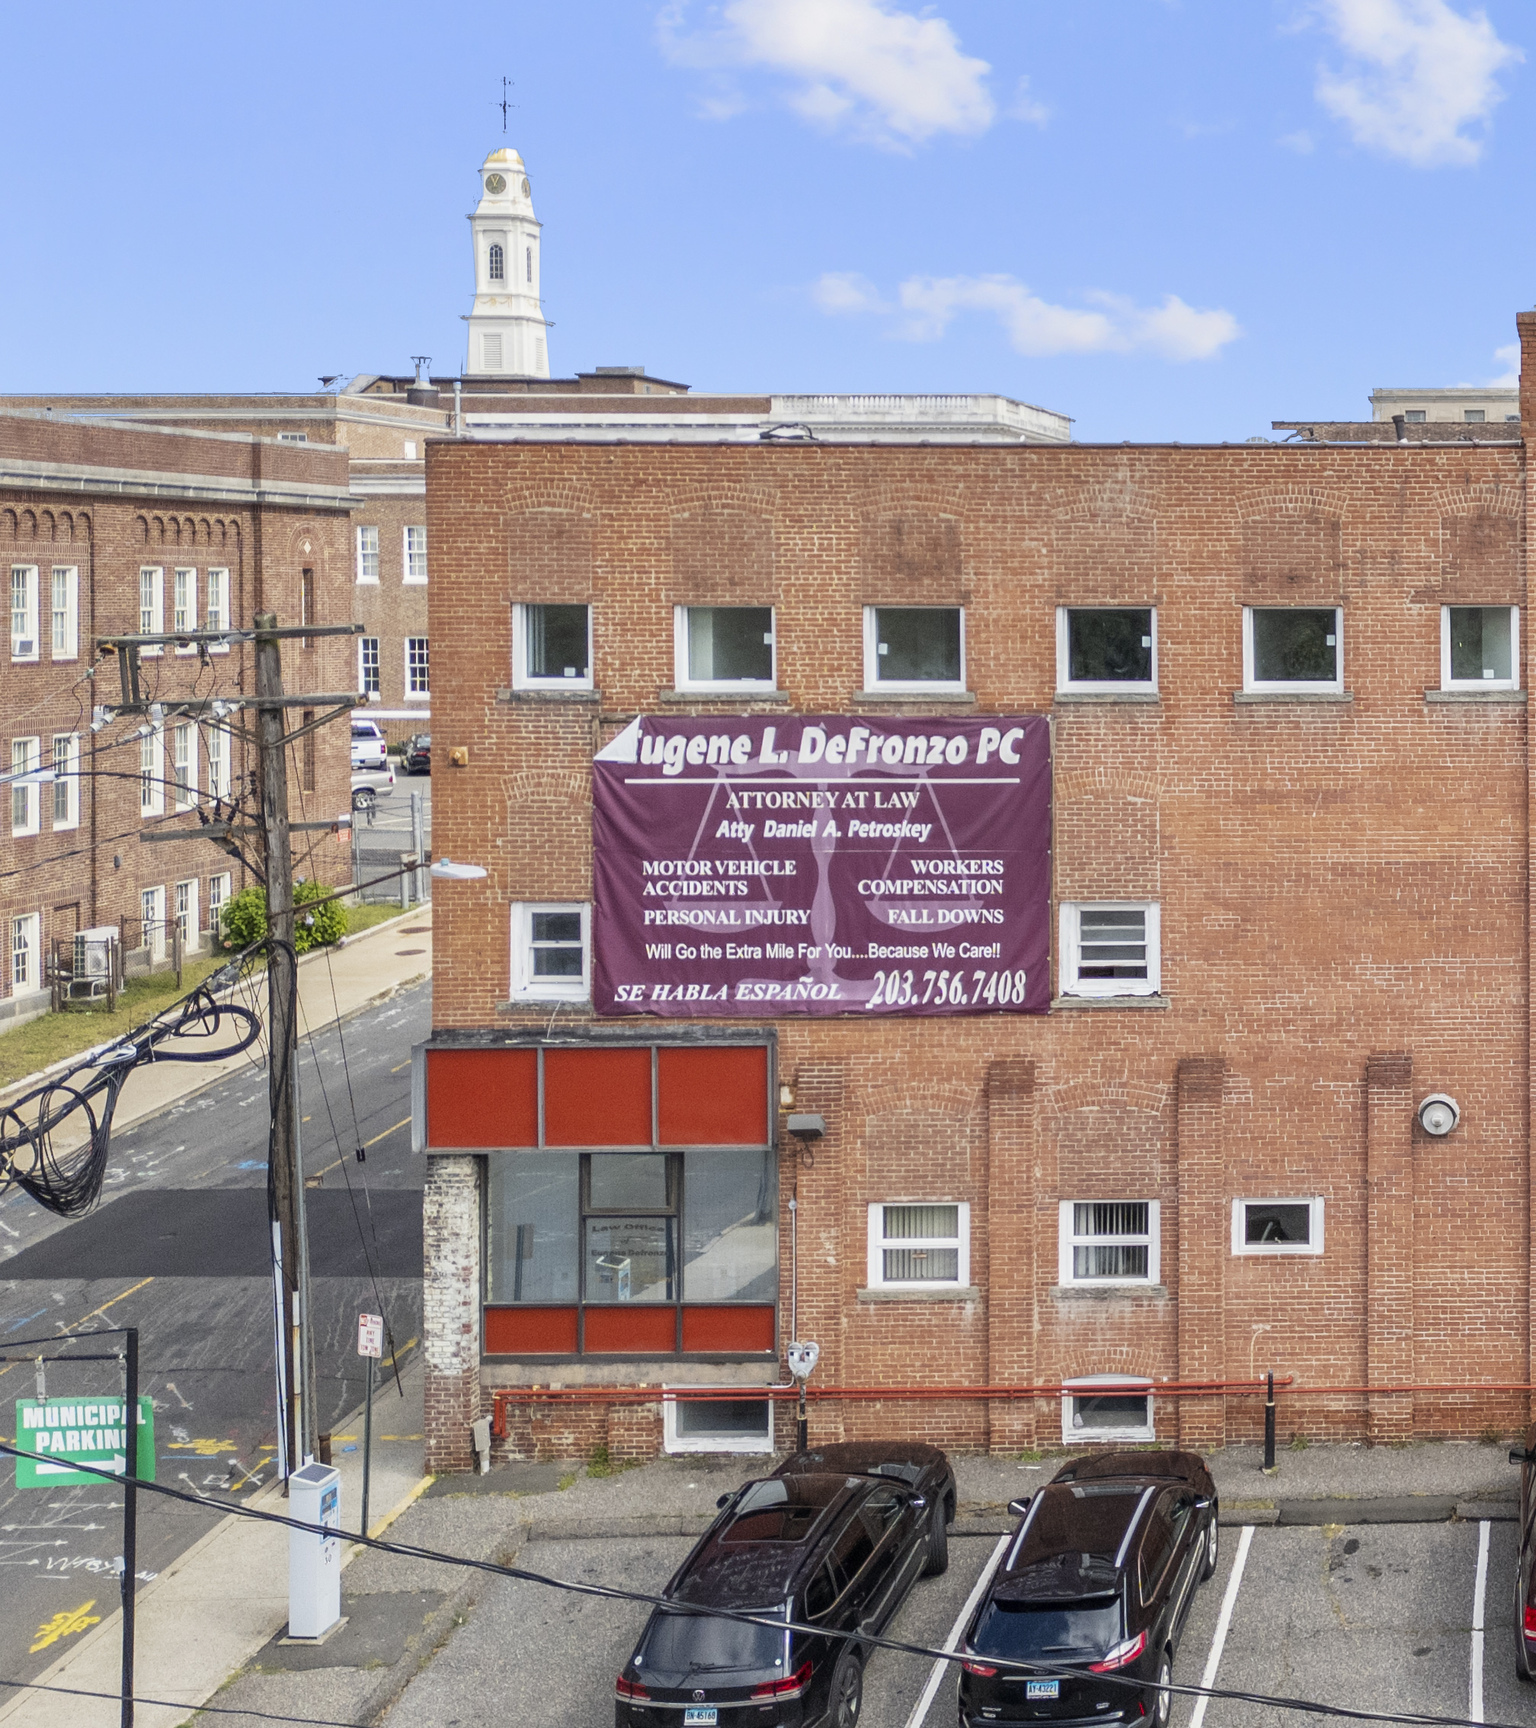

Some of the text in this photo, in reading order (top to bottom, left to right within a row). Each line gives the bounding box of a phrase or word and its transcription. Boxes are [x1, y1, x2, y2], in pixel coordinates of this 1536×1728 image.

[636, 726, 1025, 776] ugene L. DeFronzo PC
[726, 791, 920, 810] ATTORNEY AT LAW
[715, 819, 932, 843] Atty Daniel A. Petroskey
[642, 860, 797, 877] MOTOR VEHICLE
[910, 859, 1004, 876] WORKERS
[642, 880, 748, 896] ACCIDENTS
[857, 879, 1004, 896] COMPENSATION
[644, 909, 811, 926] PERSONAL INJURY
[887, 908, 1004, 925] FALL DOWNS
[645, 943, 671, 960] Will
[675, 943, 697, 960] Go
[700, 943, 722, 960] the
[726, 943, 762, 960] Extra
[766, 943, 794, 960] Mile
[798, 943, 821, 960] For
[931, 942, 956, 959] We
[958, 942, 1001, 959] Care!!
[614, 969, 1026, 1005] SE HABLA ESPAÑOL 203.756.7408
[591, 1224, 620, 1233] Law
